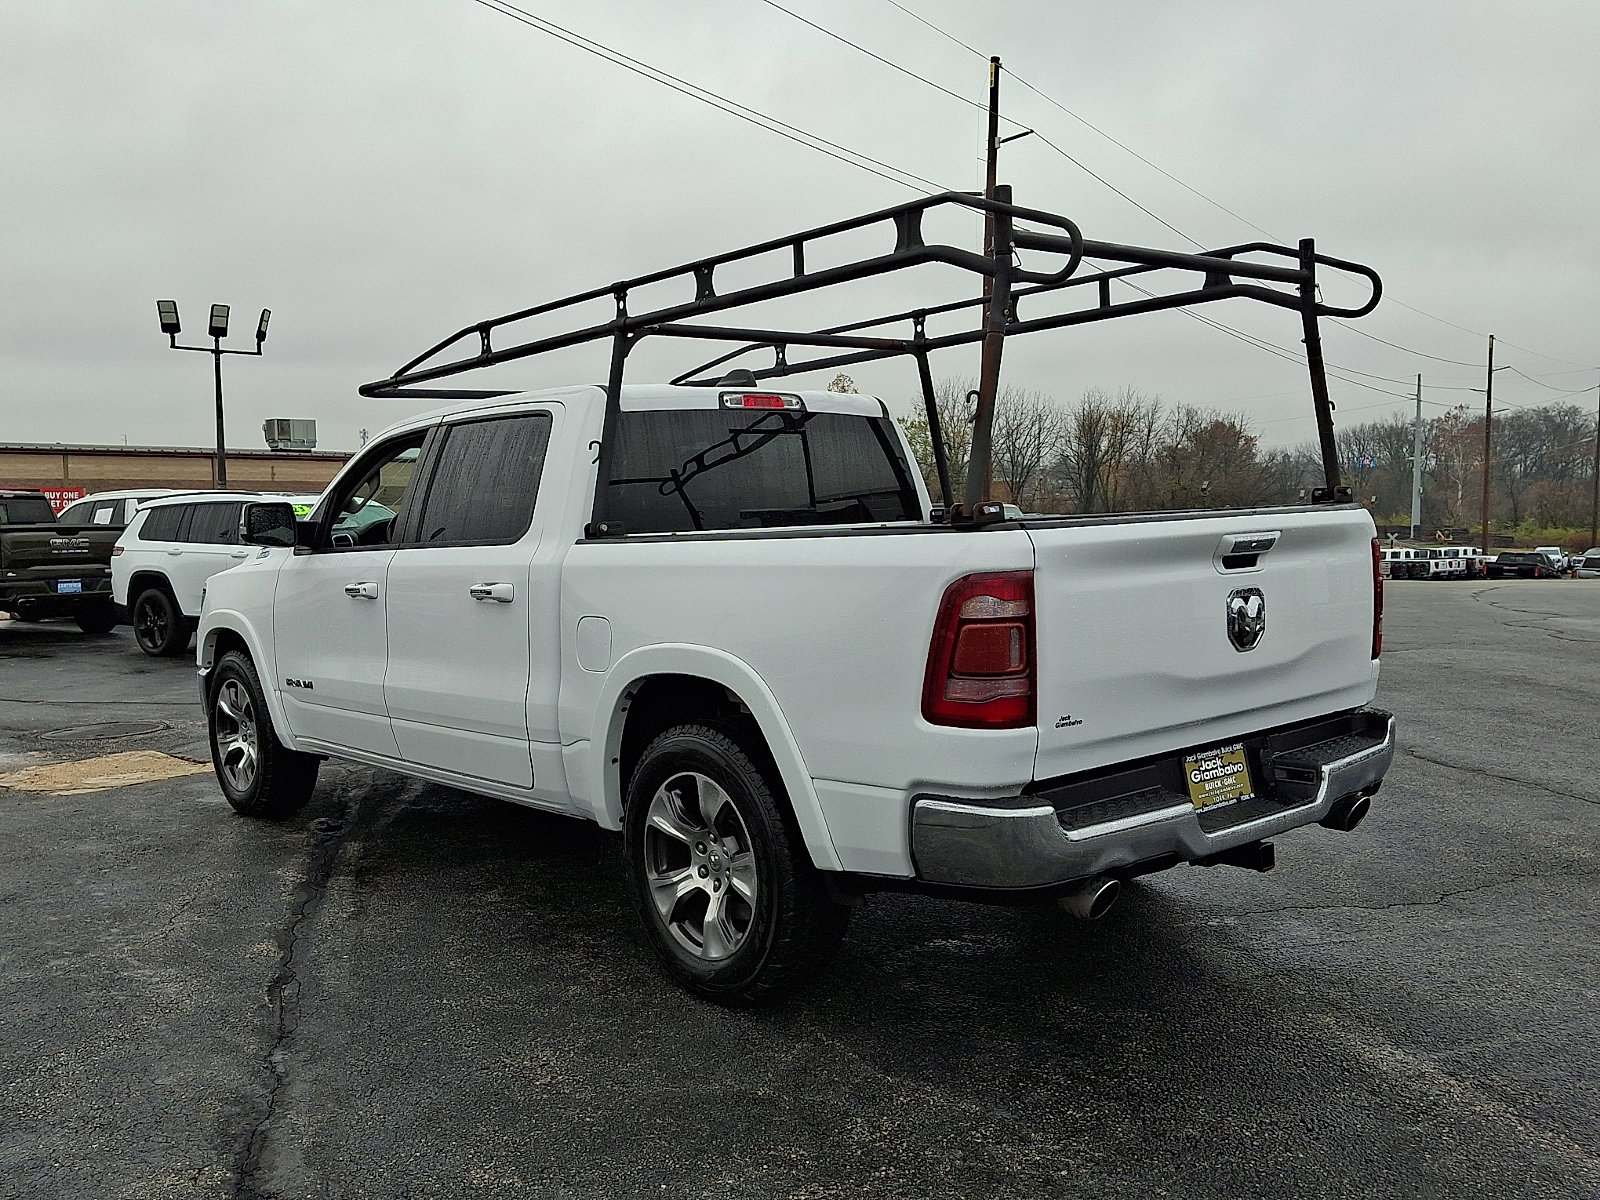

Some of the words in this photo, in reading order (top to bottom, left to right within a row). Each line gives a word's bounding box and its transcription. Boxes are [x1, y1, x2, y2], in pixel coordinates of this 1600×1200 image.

[44, 491, 60, 499] BUY
[62, 491, 79, 499] ONE
[50, 538, 89, 547] GMC
[1232, 742, 1244, 751] GMC
[1200, 757, 1223, 771] Jack
[1191, 763, 1244, 782] Giambalvo
